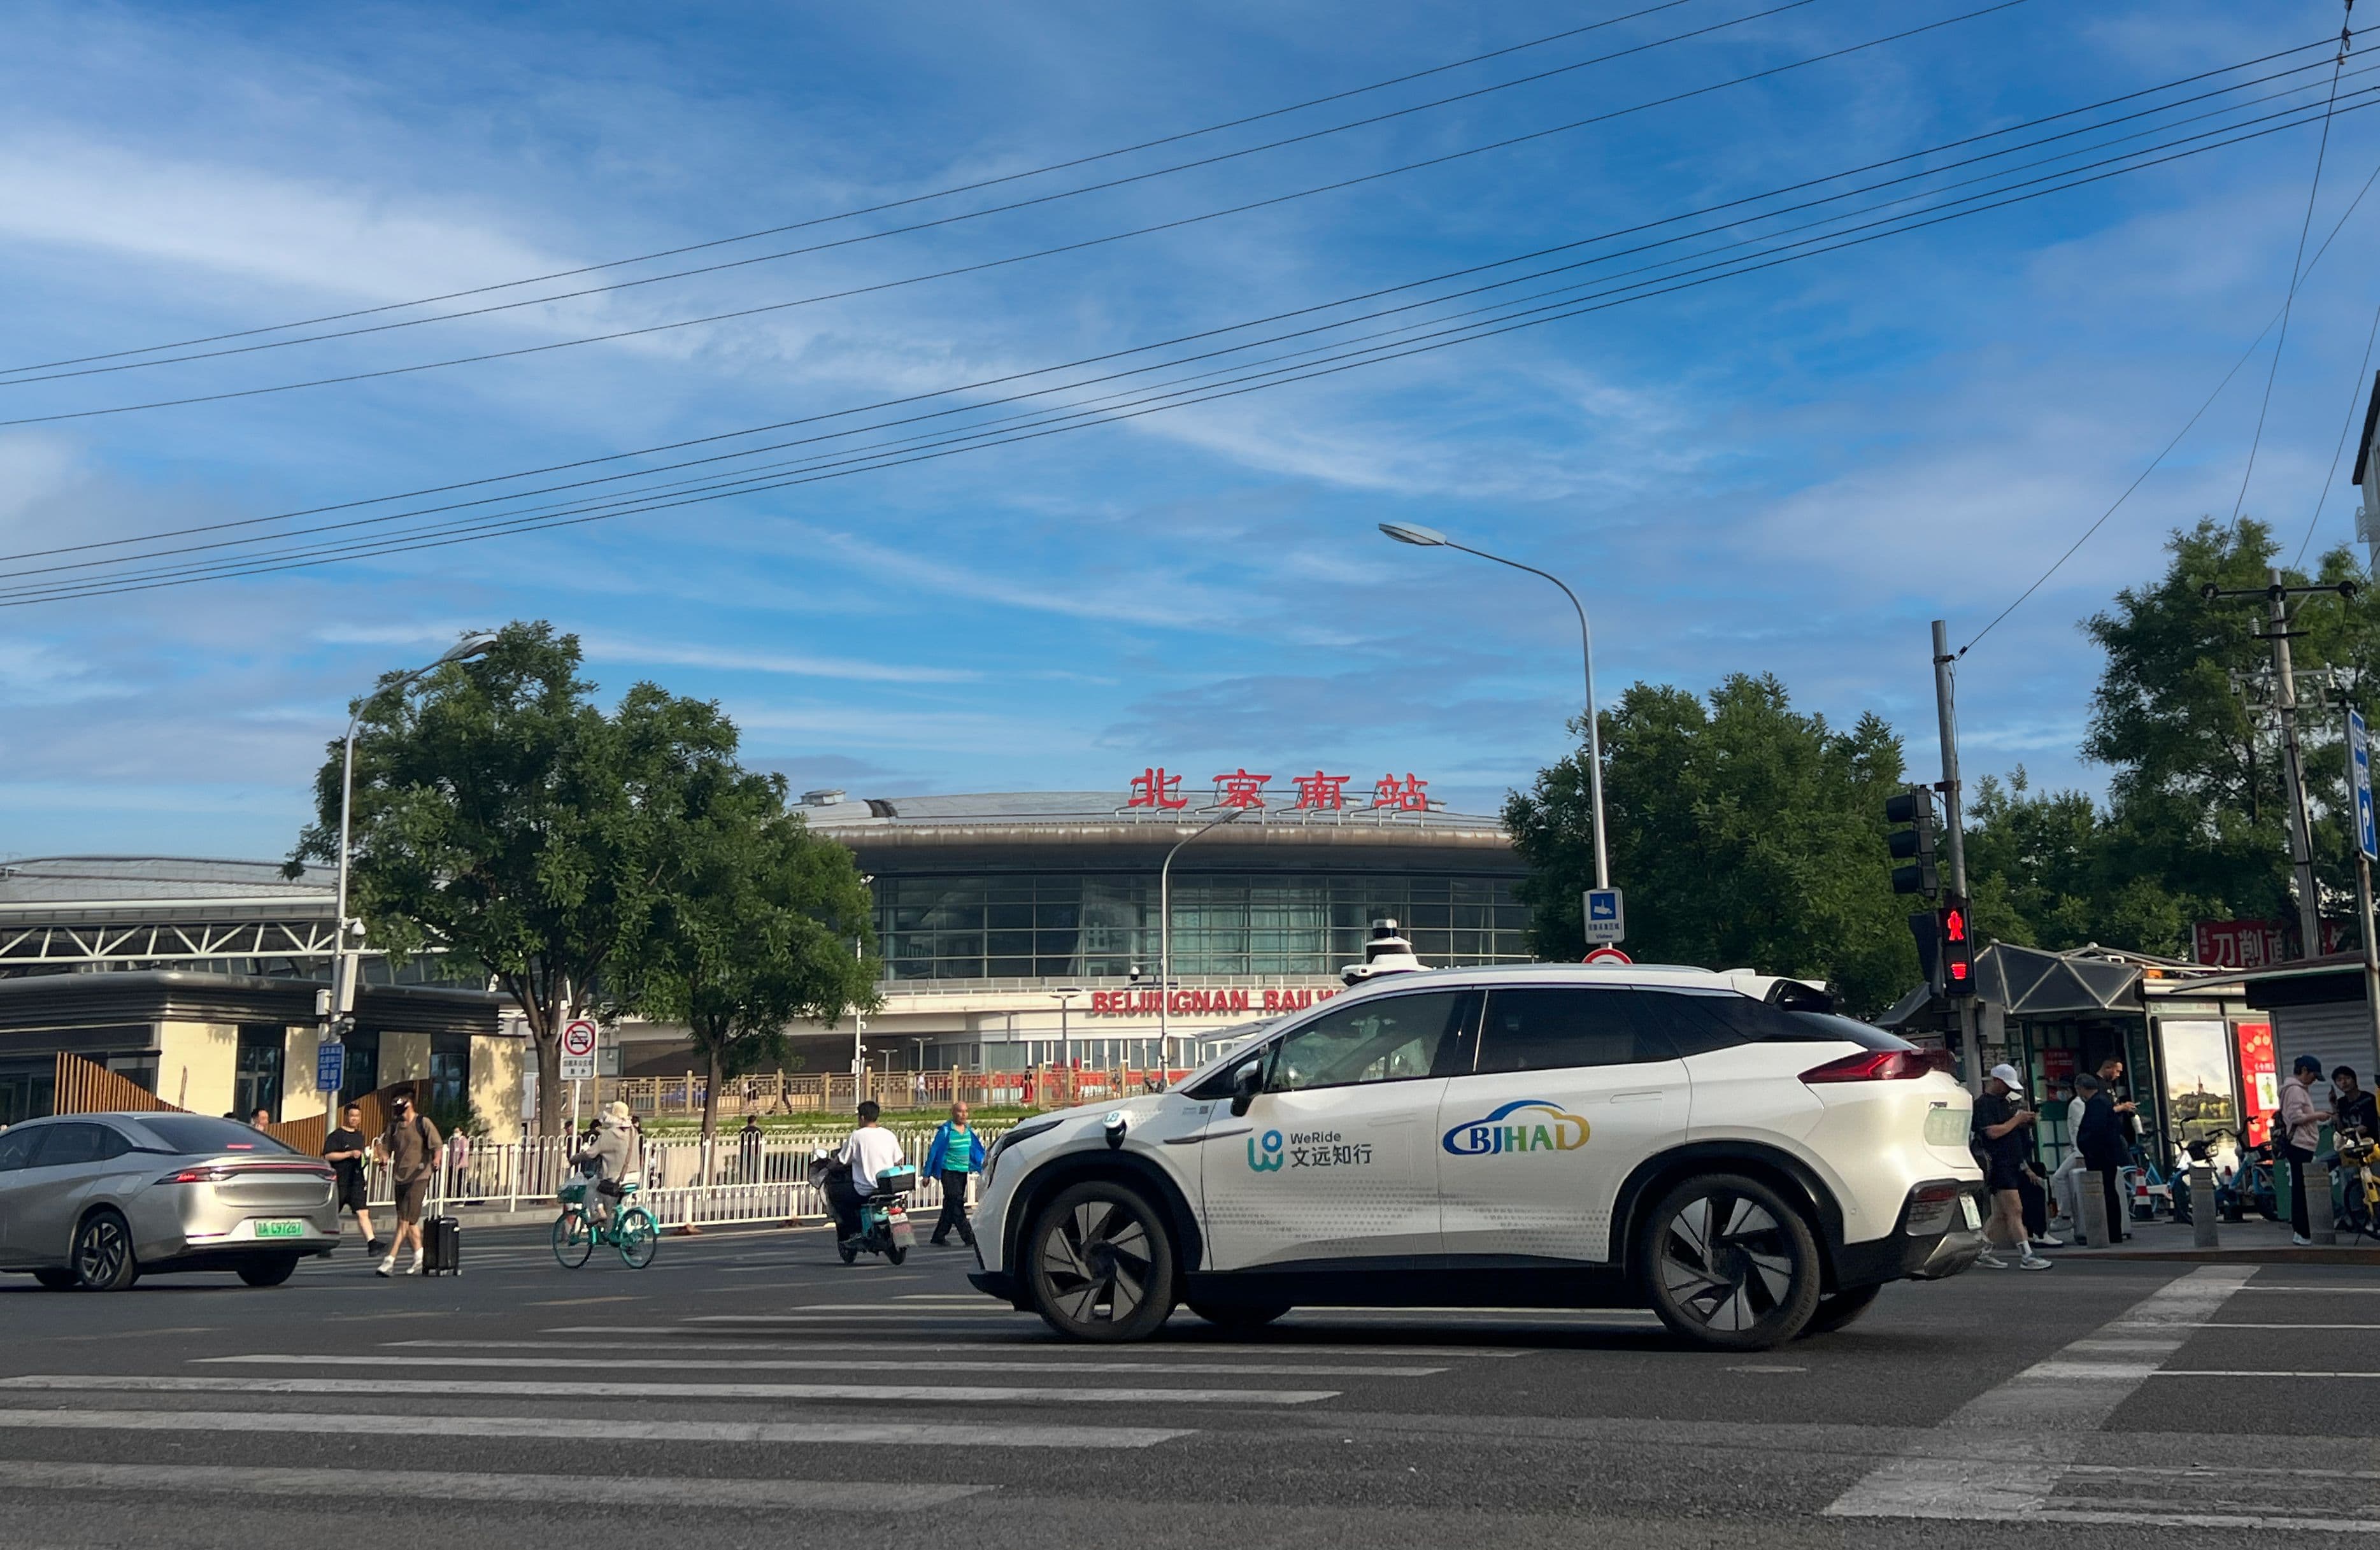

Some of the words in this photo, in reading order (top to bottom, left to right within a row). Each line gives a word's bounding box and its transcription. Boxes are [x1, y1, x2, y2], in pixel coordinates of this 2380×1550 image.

[1128, 767, 1428, 810] 北京南站
[1092, 990, 1249, 1013] BEIJINGNAN
[1290, 1130, 1341, 1145] WeRide
[1466, 1113, 1591, 1155] BJHAD
[1290, 1143, 1372, 1168] 文远知行
